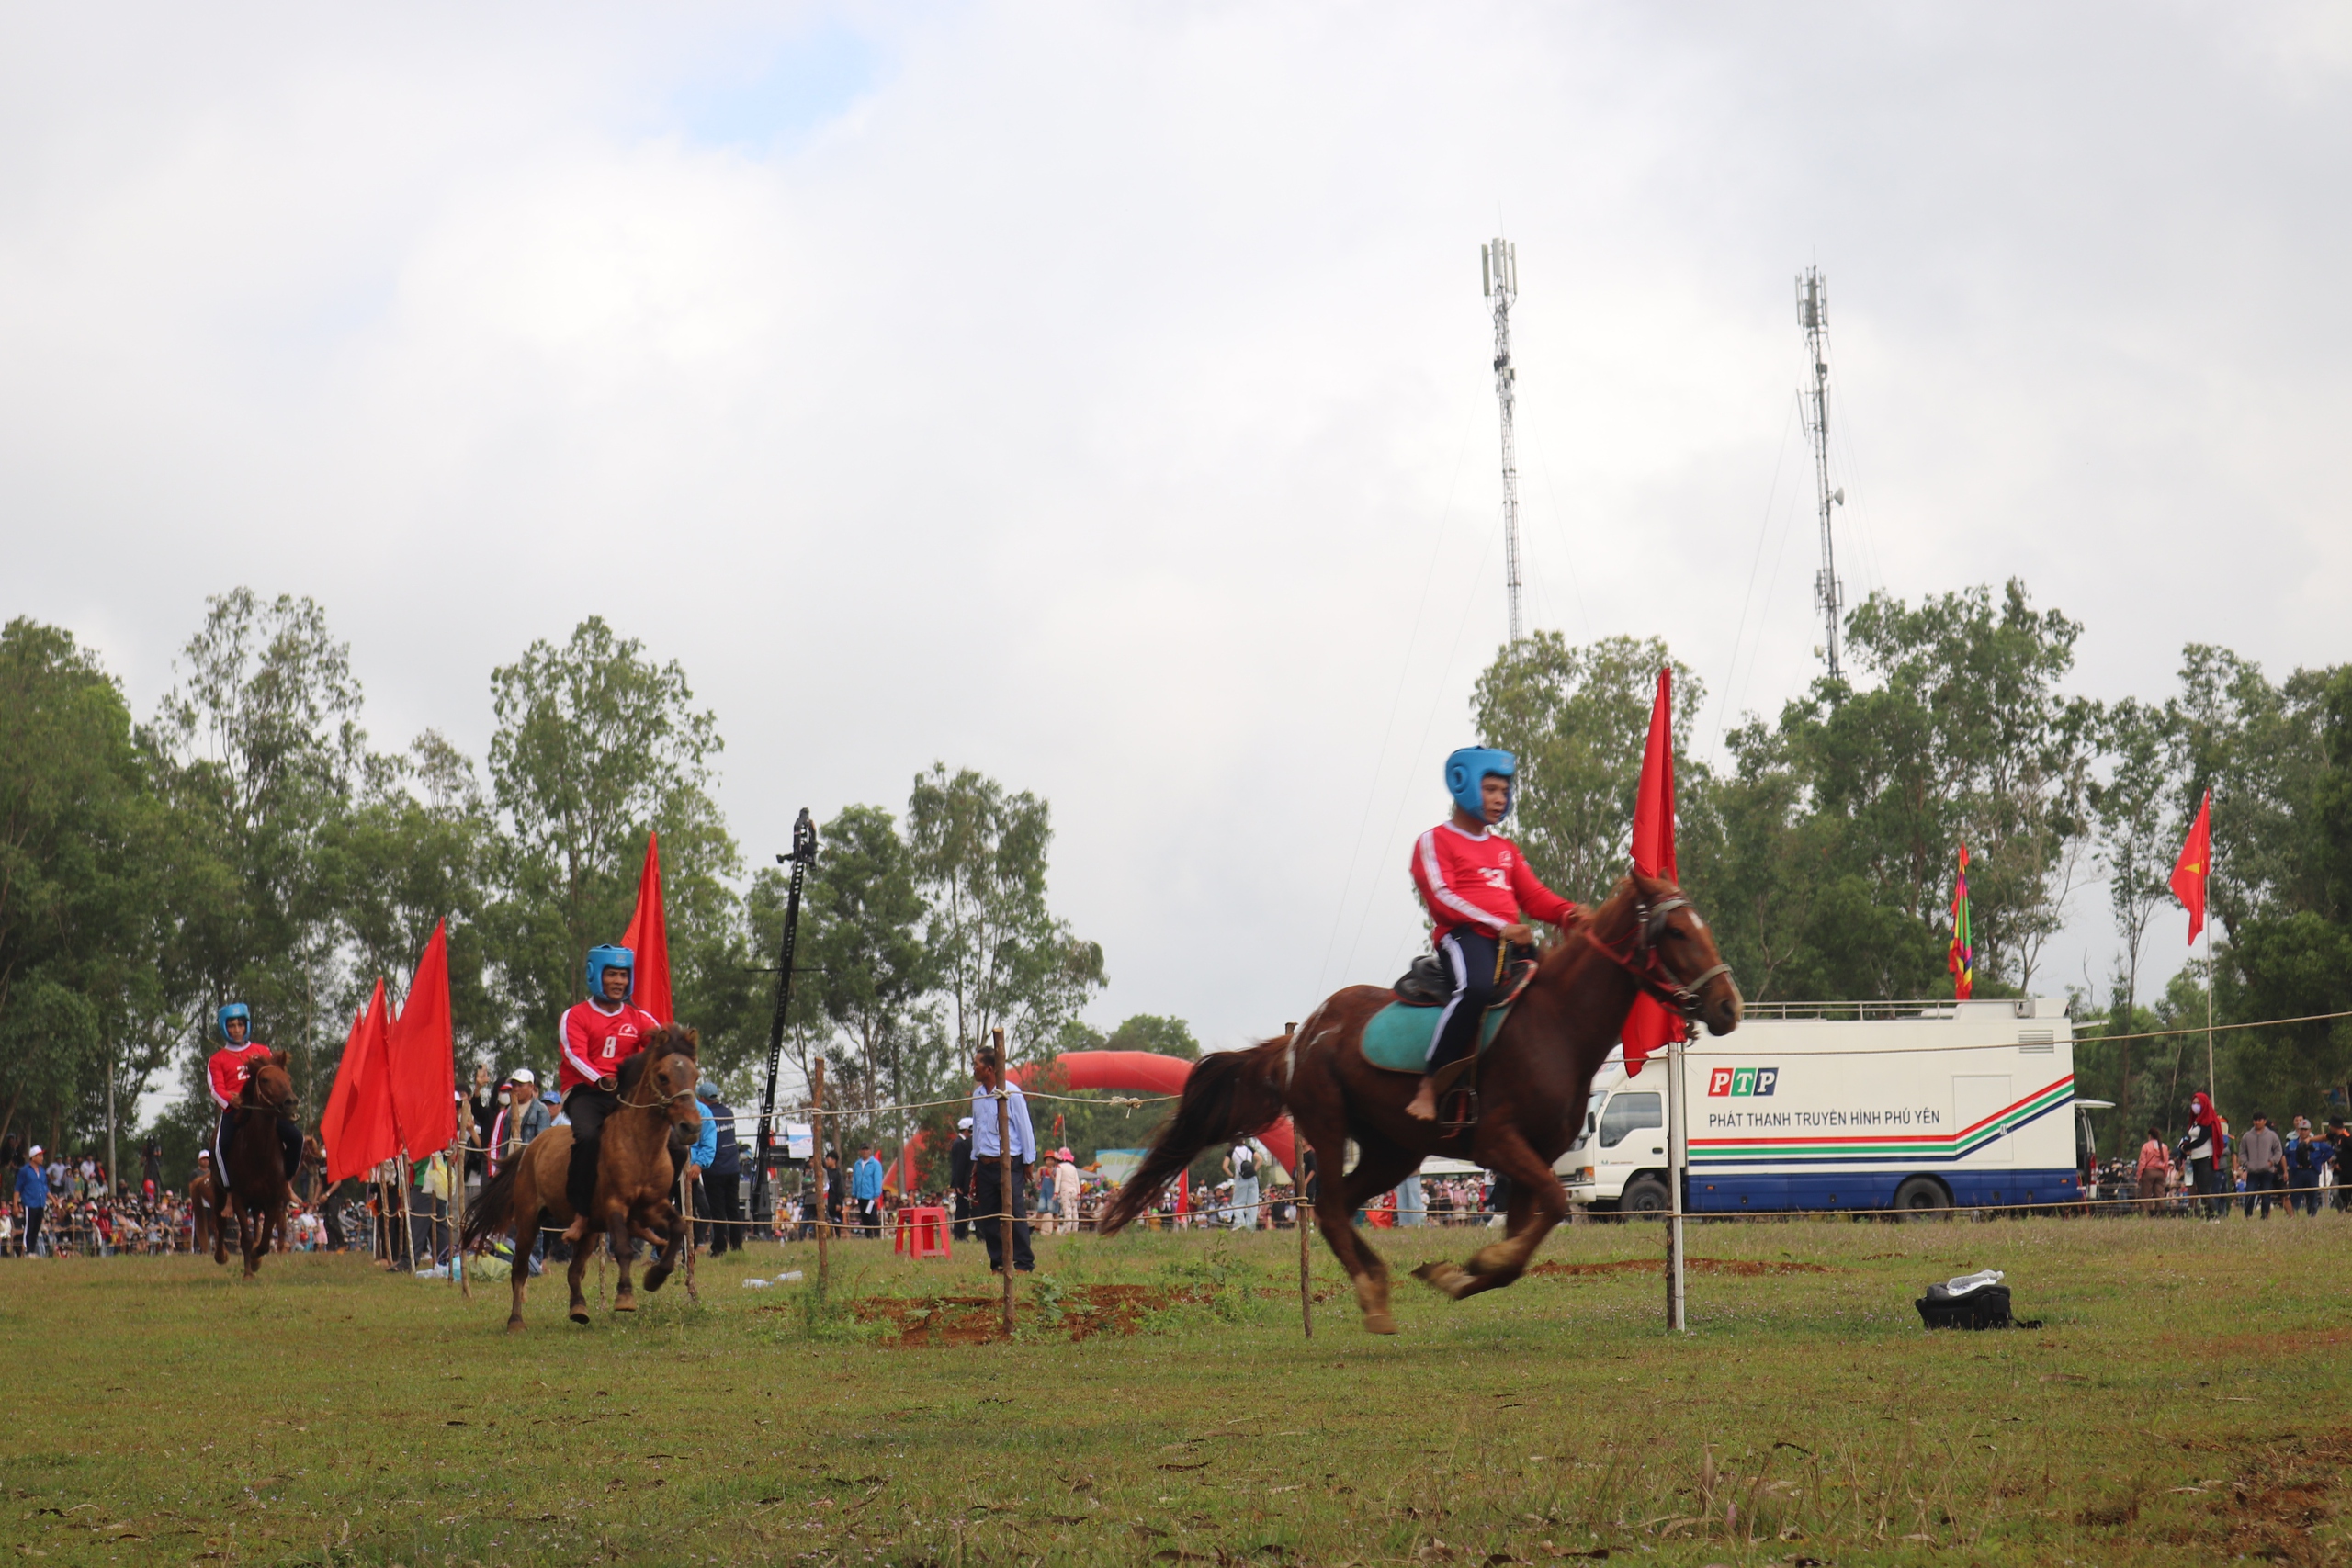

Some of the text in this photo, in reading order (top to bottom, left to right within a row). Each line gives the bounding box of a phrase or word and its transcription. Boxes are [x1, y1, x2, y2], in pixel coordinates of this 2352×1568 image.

[602, 1036, 616, 1058] 8
[236, 1065, 251, 1080] 2
[1711, 1071, 1777, 1094] PTP
[1709, 1110, 1744, 1128] PHÁT
[1747, 1112, 1791, 1127] THANH
[1850, 1108, 1881, 1125] HÌNH
[1885, 1107, 1911, 1125] PHÚ
[1914, 1106, 1940, 1124] YÊN
